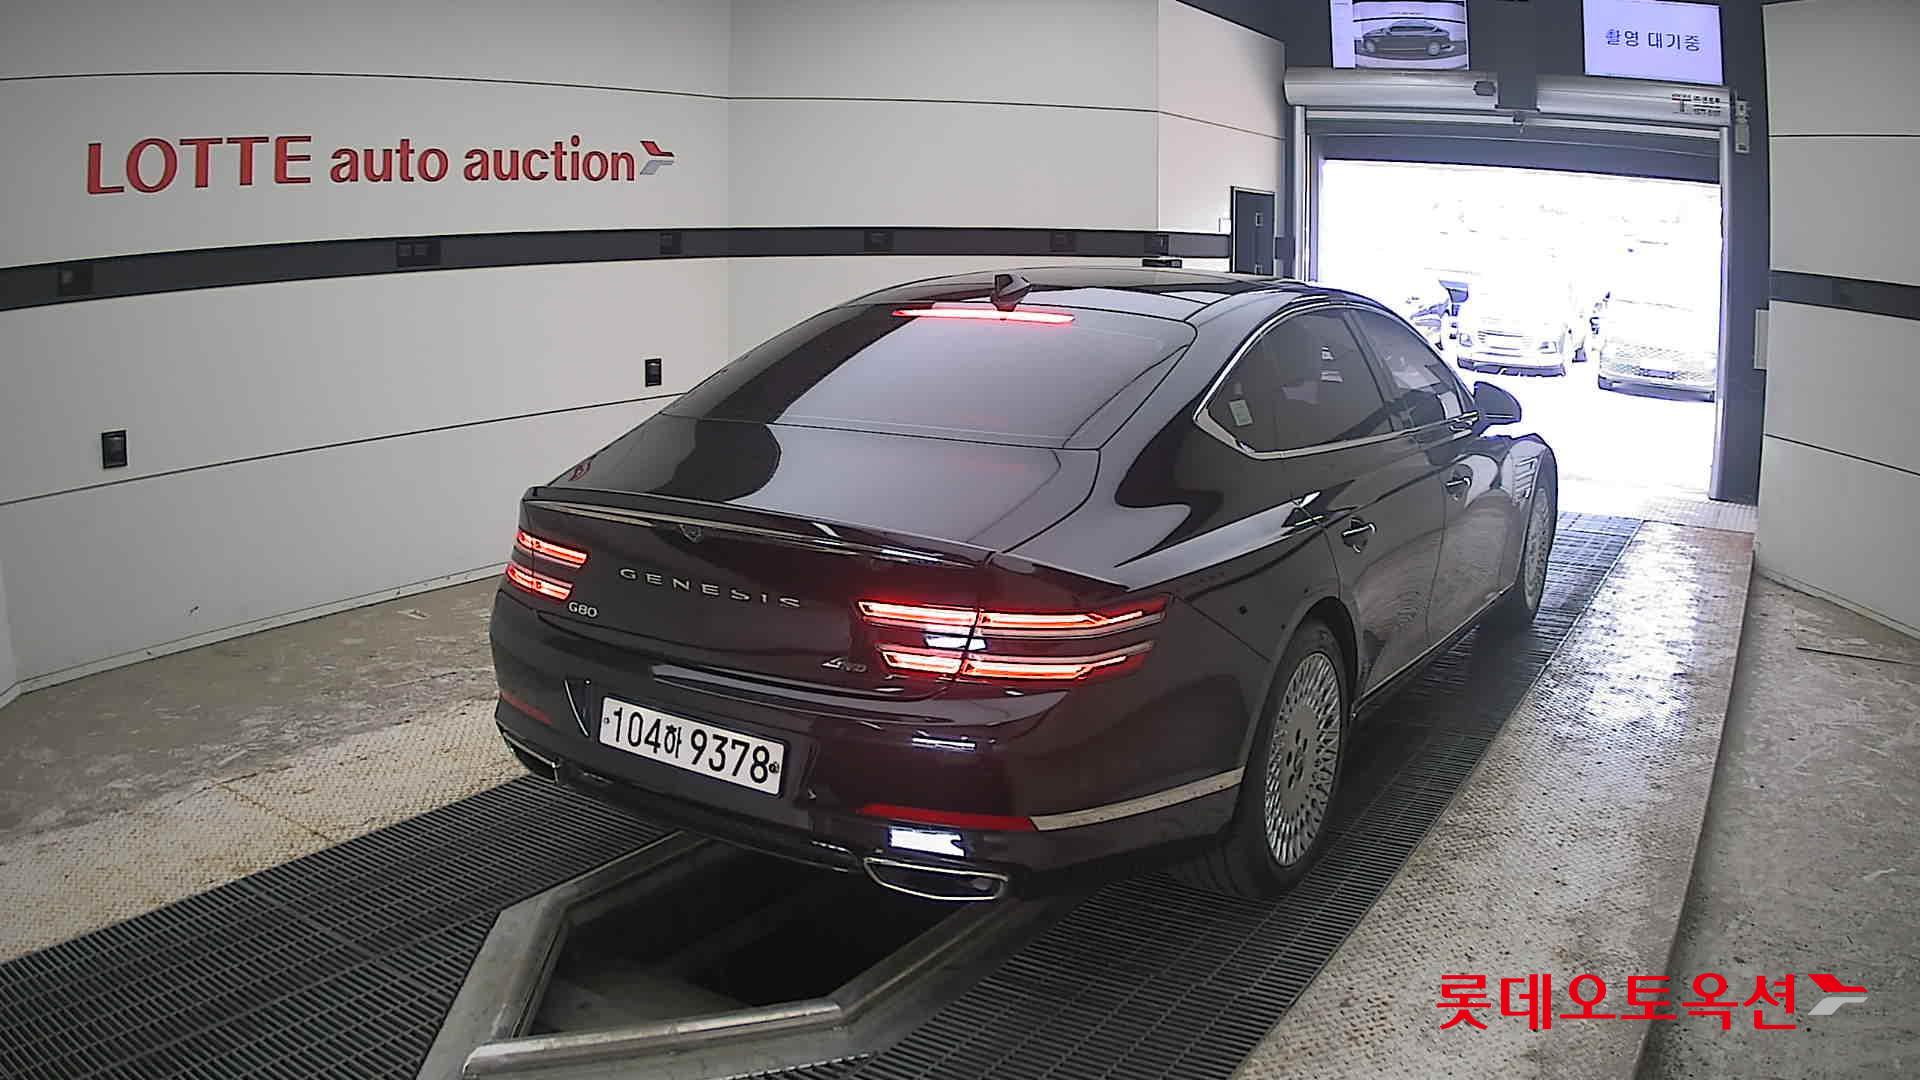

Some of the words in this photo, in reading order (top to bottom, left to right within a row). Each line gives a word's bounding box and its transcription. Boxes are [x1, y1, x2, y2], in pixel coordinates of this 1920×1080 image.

[1648, 32, 1700, 51] 대기중
[87, 135, 312, 195] LOTTE
[328, 138, 449, 182] auto
[463, 134, 635, 181] auction
[619, 568, 800, 607] GENESIS
[568, 601, 597, 617] G80
[613, 707, 682, 759] 104하
[690, 728, 770, 784] 9378
